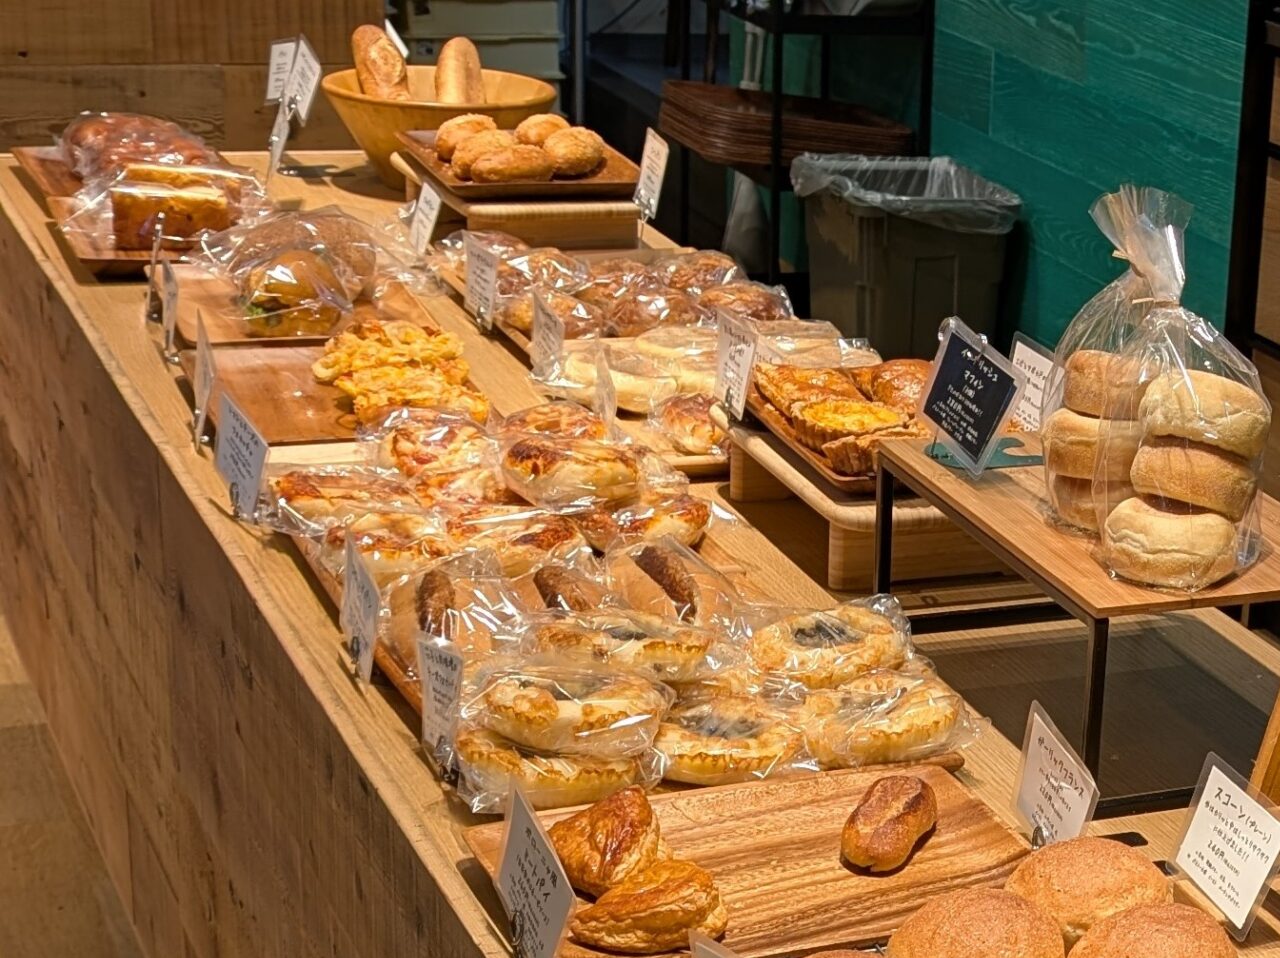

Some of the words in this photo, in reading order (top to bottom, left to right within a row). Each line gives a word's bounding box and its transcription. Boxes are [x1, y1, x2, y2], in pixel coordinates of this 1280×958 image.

[1214, 787, 1272, 845] スコーン(プレーン)
